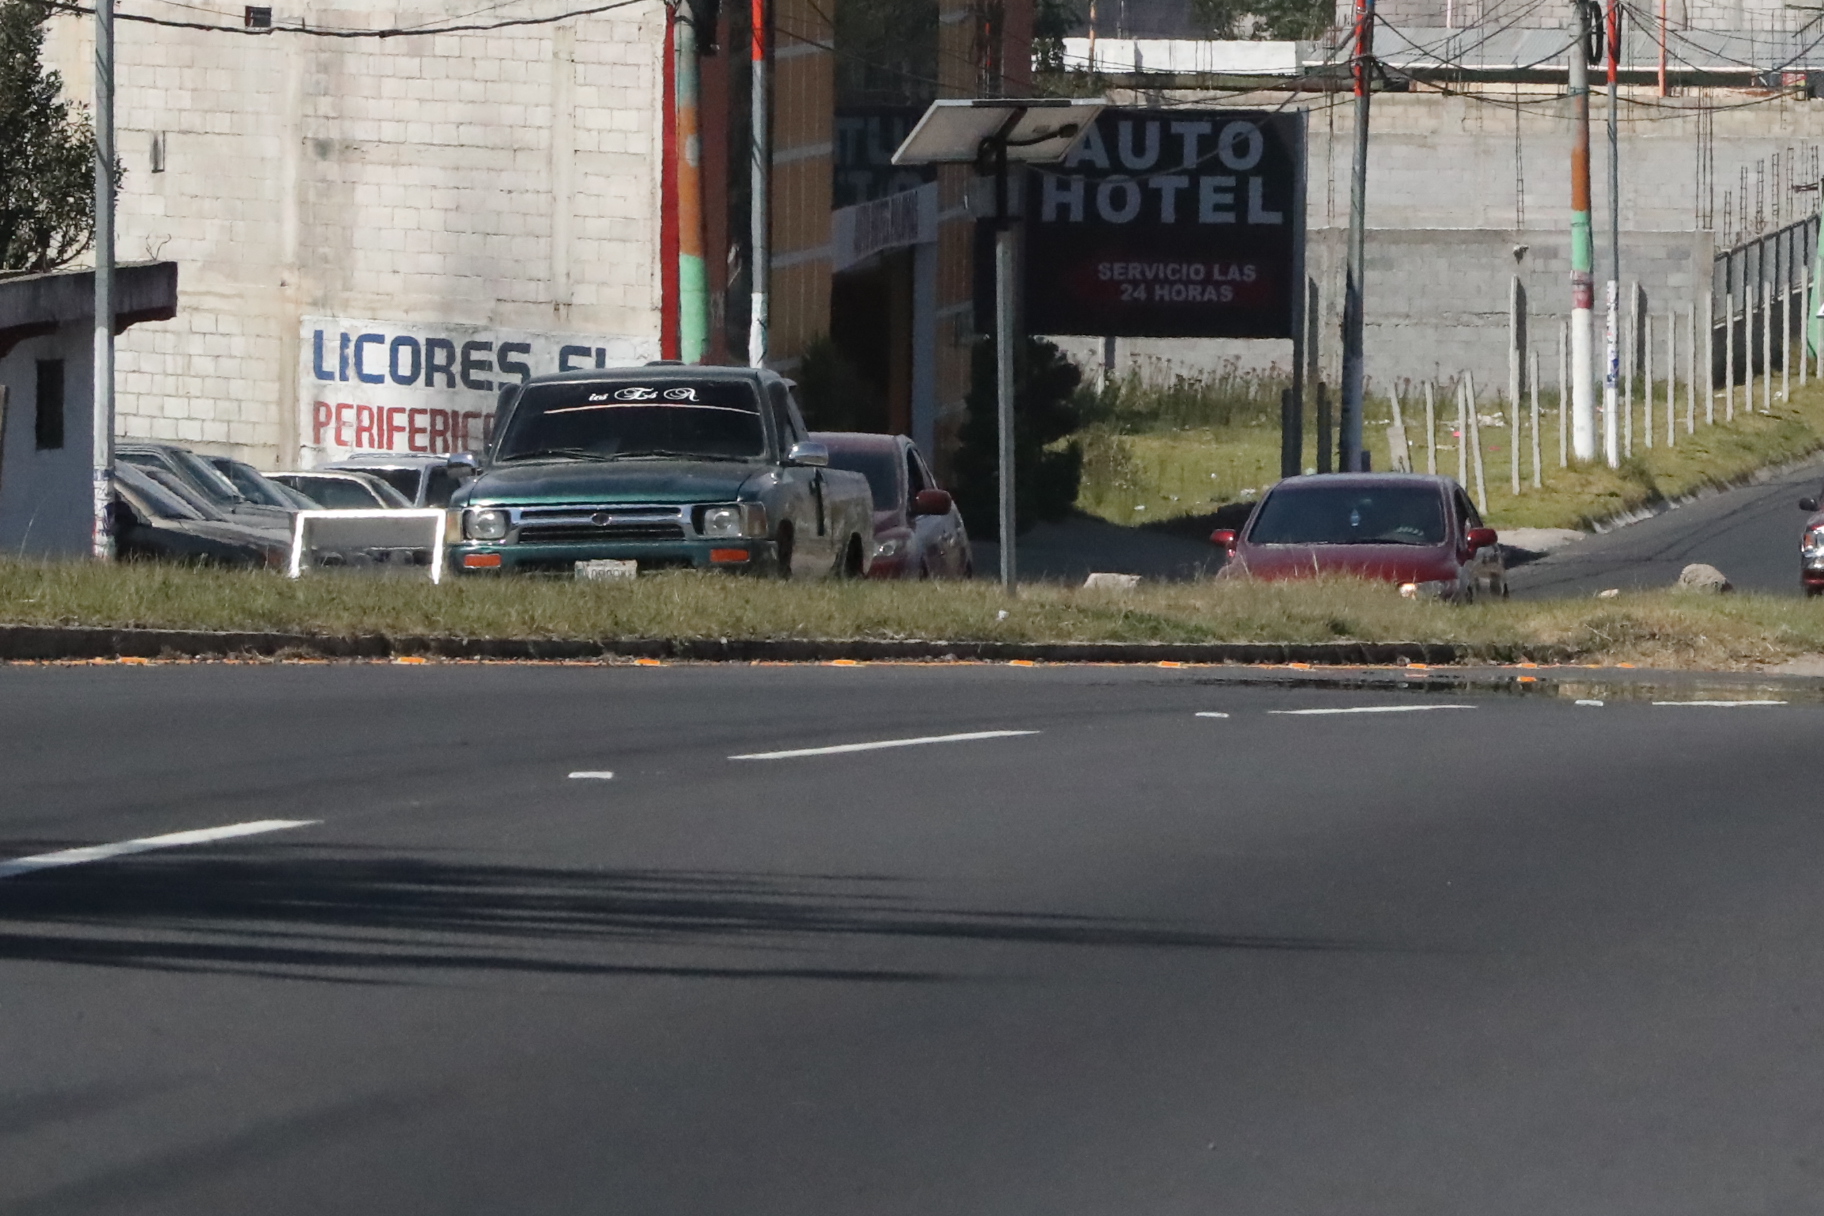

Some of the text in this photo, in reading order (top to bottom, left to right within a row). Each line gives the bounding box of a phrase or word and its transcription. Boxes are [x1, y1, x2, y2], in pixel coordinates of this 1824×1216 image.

[1057, 119, 1266, 171] AUTO
[1040, 175, 1284, 226] HOTEL
[1097, 261, 1258, 283] SERVICIO LAS
[1119, 282, 1235, 304] 24 HORAS
[312, 329, 532, 392] LICORES
